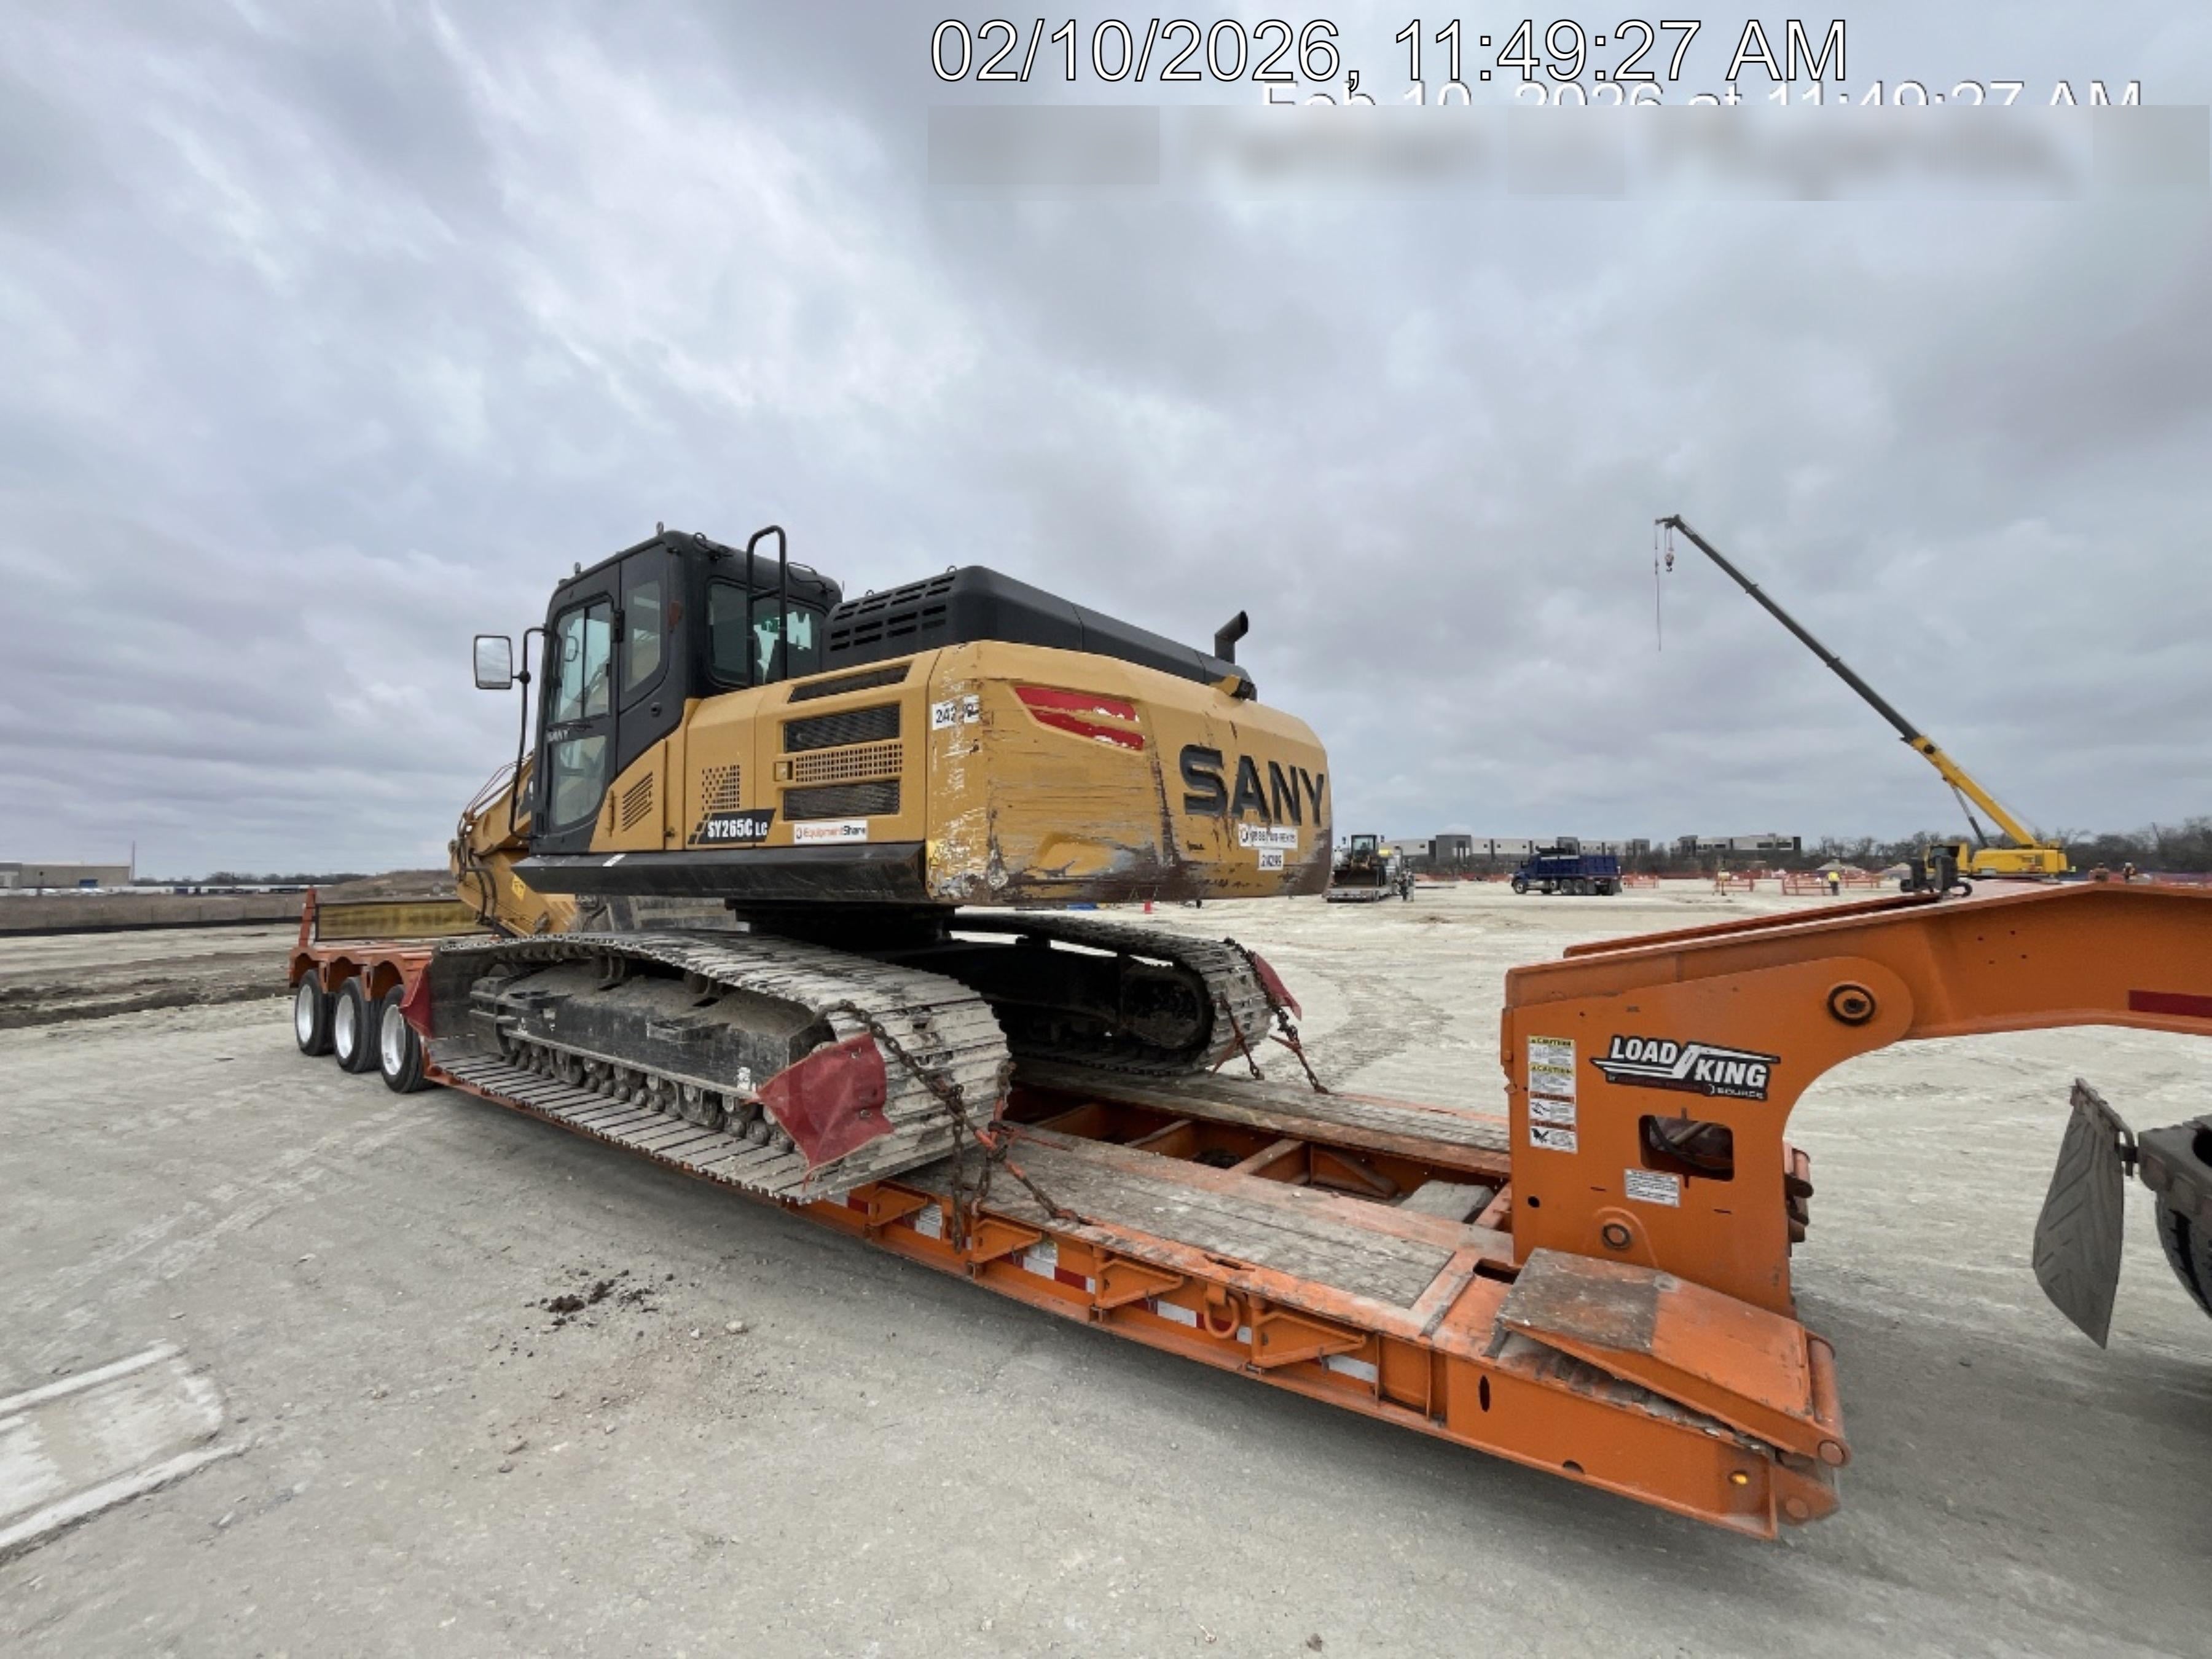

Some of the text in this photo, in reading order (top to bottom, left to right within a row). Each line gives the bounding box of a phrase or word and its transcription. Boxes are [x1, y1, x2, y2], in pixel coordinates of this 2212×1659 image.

[1179, 744, 1325, 826] SANY
[708, 818, 767, 838] SY265C LC
[1610, 1037, 1678, 1065] LOAD
[1693, 1058, 1767, 1088] KING
